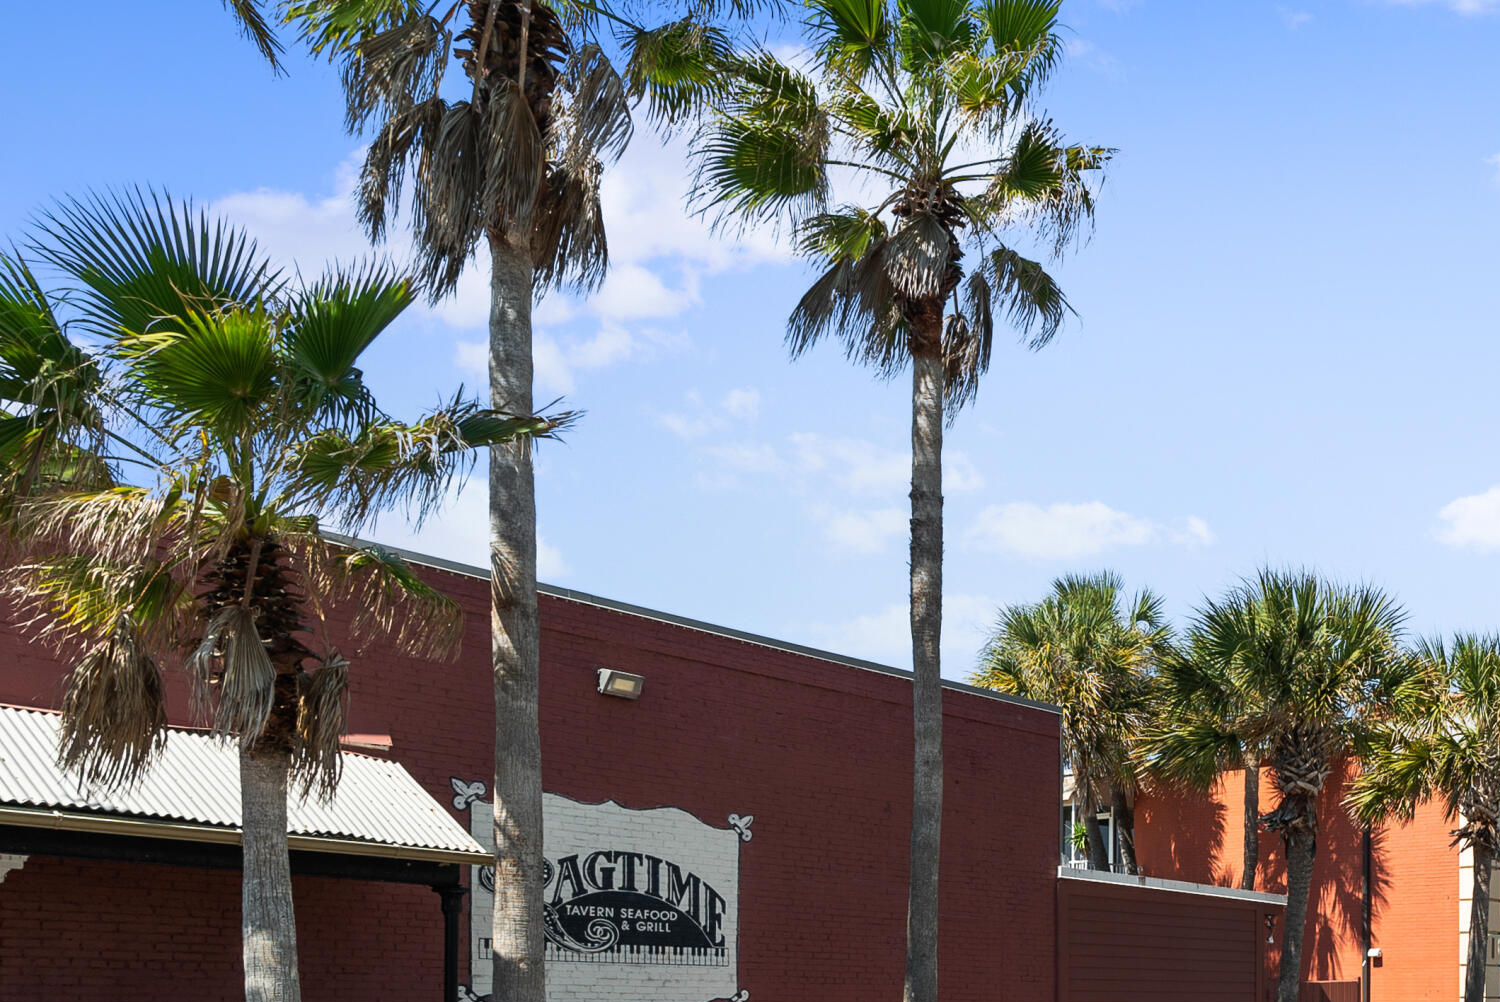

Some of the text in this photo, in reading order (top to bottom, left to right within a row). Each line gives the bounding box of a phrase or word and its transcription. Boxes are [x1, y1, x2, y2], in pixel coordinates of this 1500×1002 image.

[541, 850, 727, 947] AGTIME
[565, 904, 678, 921] TAVERN SEAFOOD
[621, 920, 671, 933] & GRILL
